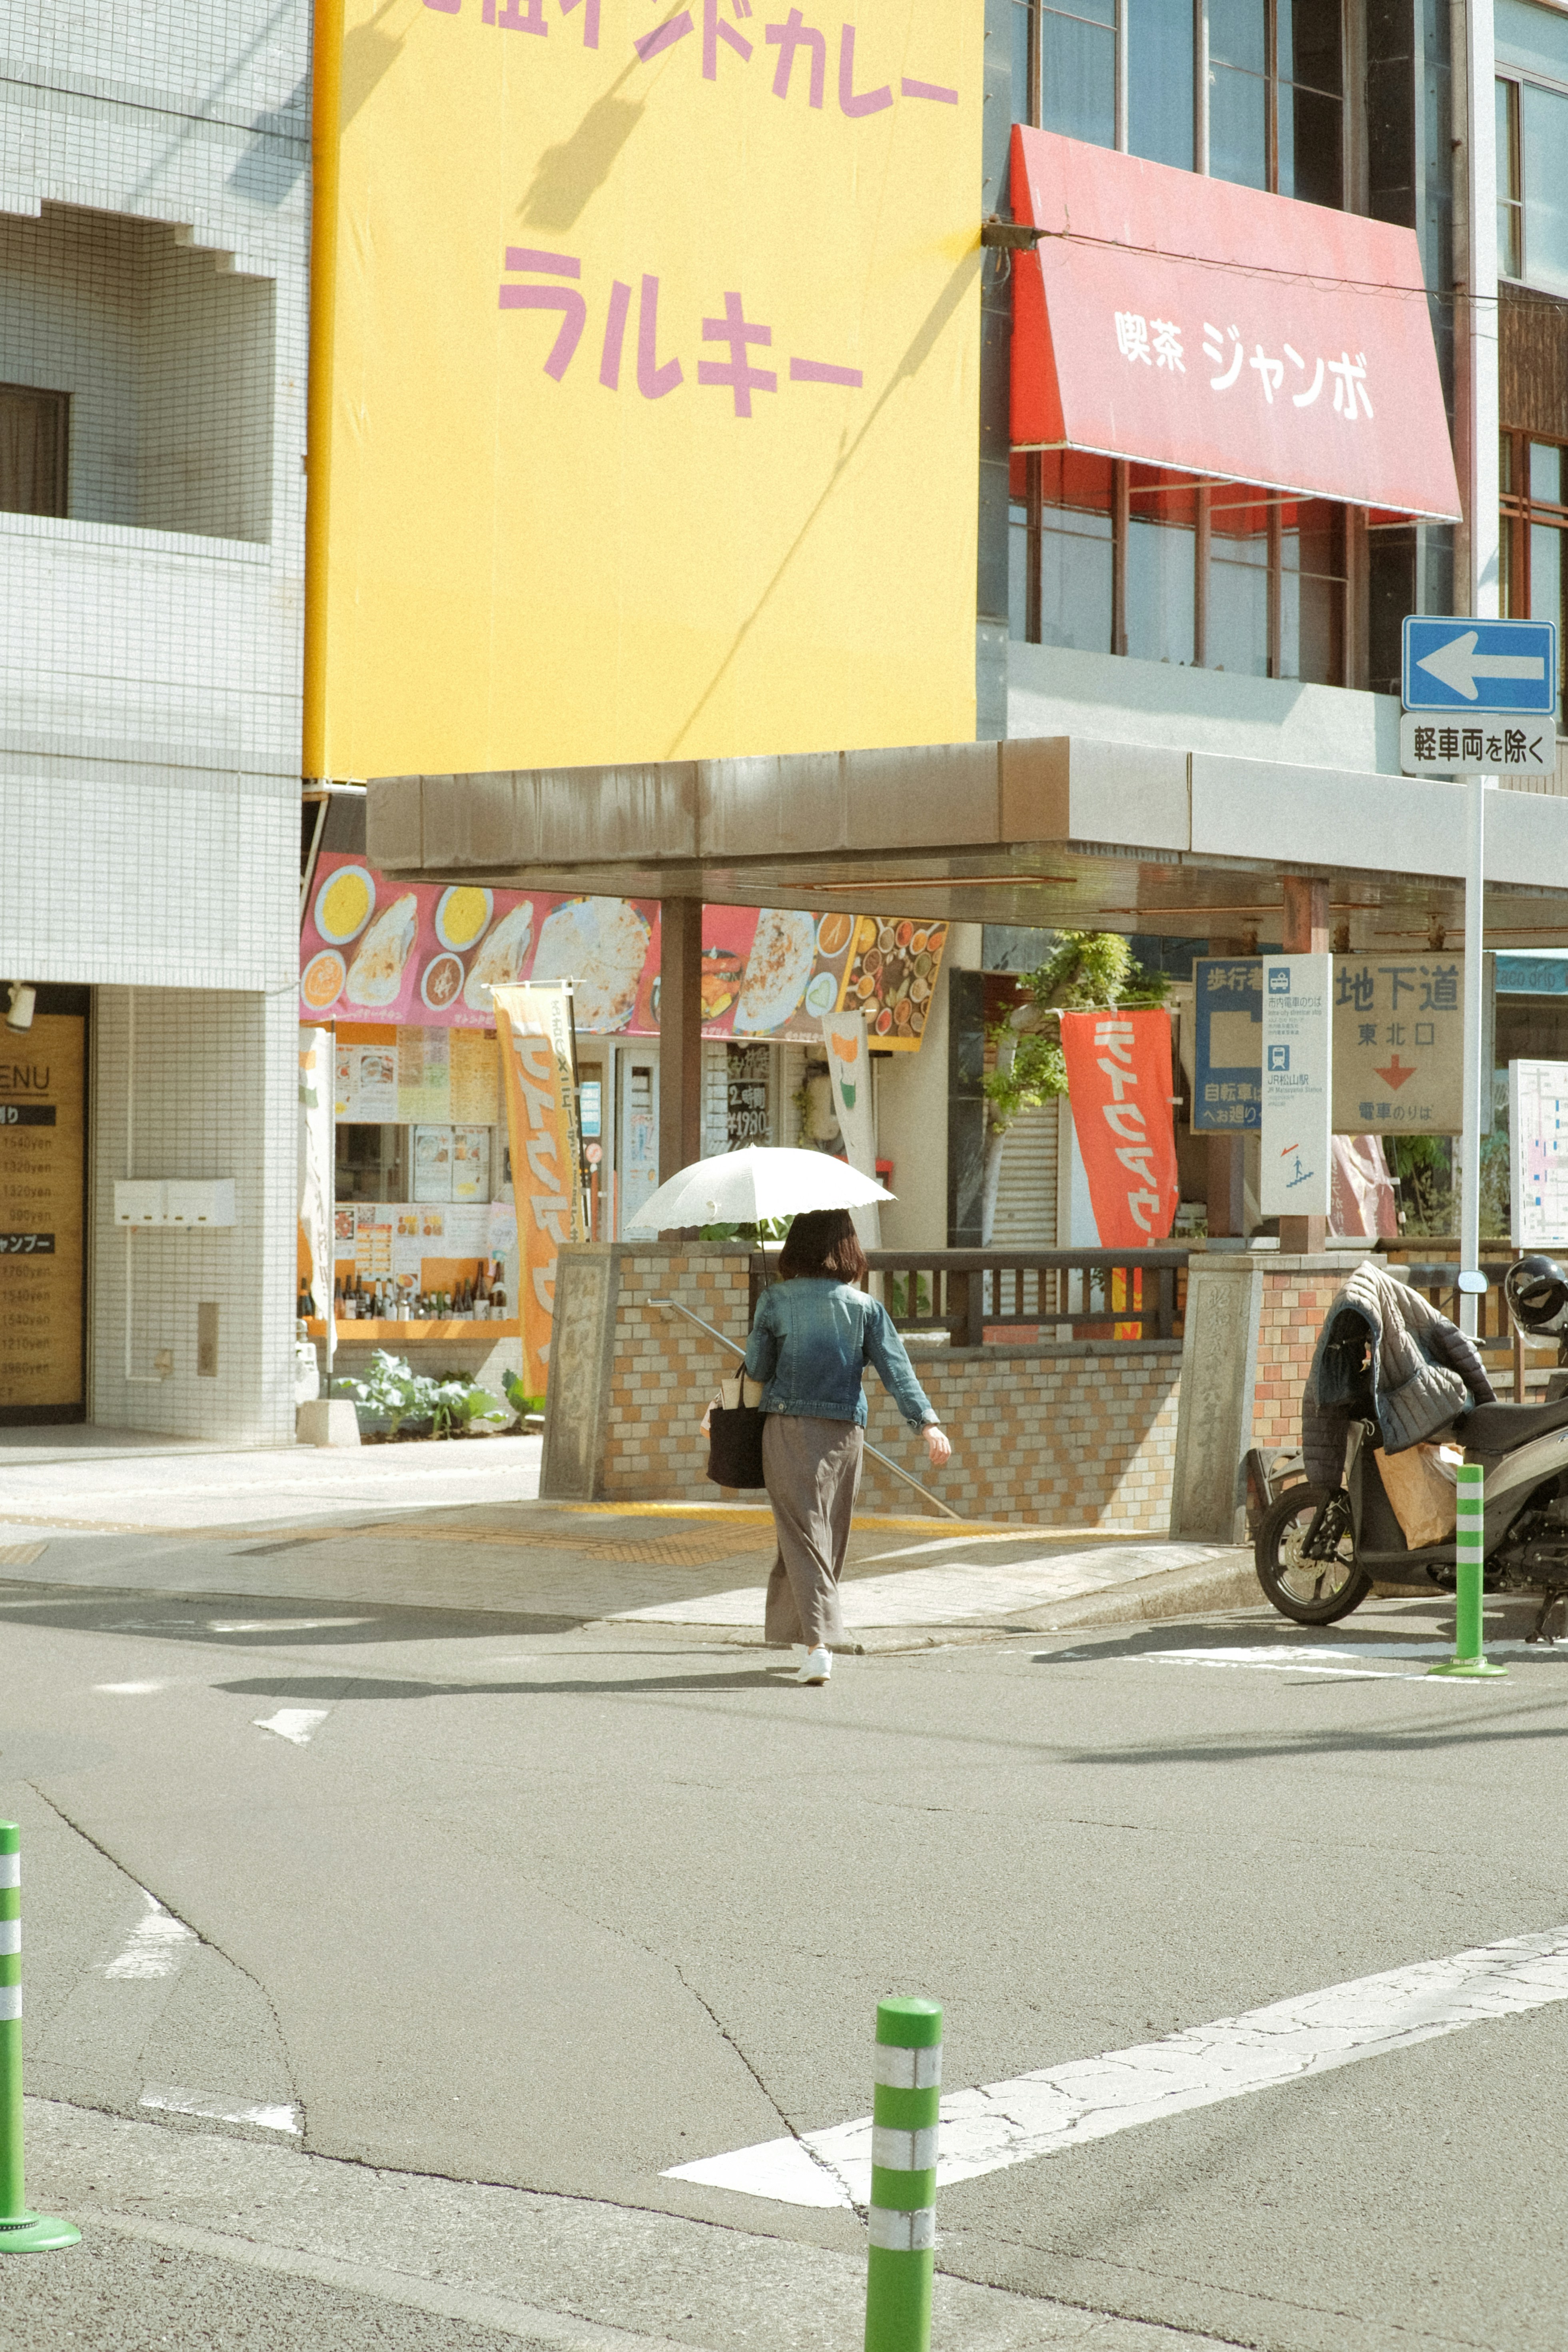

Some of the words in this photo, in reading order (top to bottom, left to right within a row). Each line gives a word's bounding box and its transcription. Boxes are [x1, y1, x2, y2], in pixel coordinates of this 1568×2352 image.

[498, 246, 863, 419] ラルキー
[1114, 311, 1186, 373] 喫茶
[1202, 322, 1374, 420] ジャンボ
[1414, 726, 1543, 764] 軽車両を除く
[1335, 964, 1459, 1011] 地下道
[1268, 996, 1322, 1008] 市内電車のりば
[1358, 1022, 1434, 1046] 東北口
[1267, 1074, 1309, 1085] JR松山駅
[729, 1084, 766, 1109] 2時間
[1359, 1101, 1434, 1120] 電車のりば
